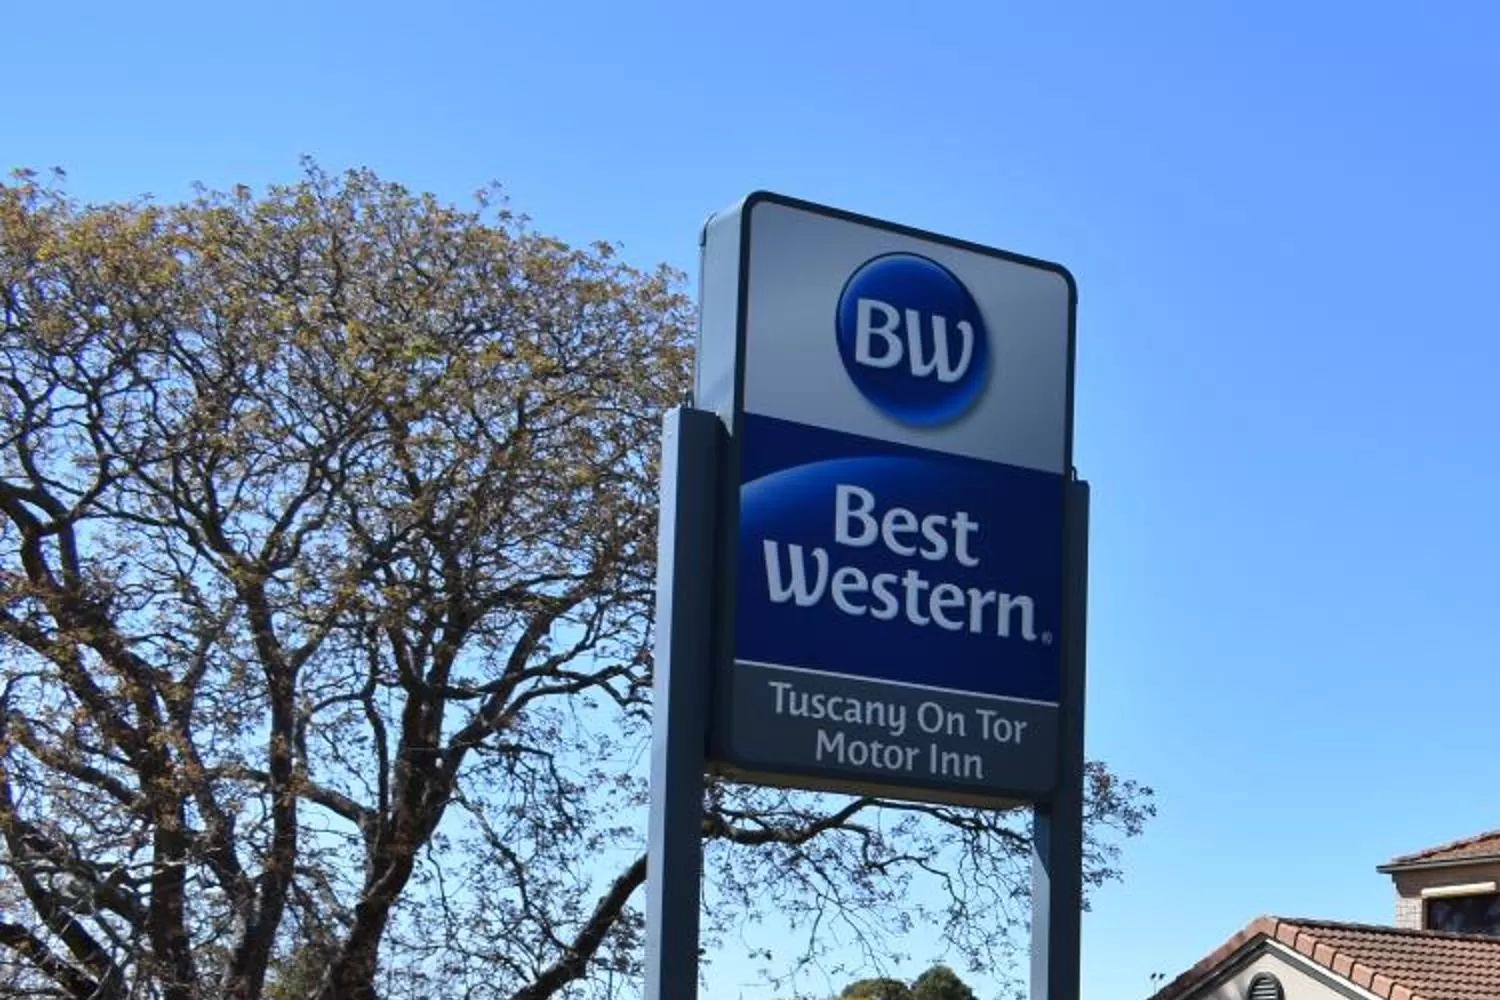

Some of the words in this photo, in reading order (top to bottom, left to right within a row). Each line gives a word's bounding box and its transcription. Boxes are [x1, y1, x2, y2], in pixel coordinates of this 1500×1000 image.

[854, 298, 974, 383] BW
[834, 484, 979, 567] Best
[763, 539, 1037, 641] Western
[768, 681, 906, 736] Tuscany
[917, 702, 966, 736] On
[976, 709, 1027, 743] Tor
[815, 729, 920, 771] Motor
[929, 744, 984, 779] Inn
